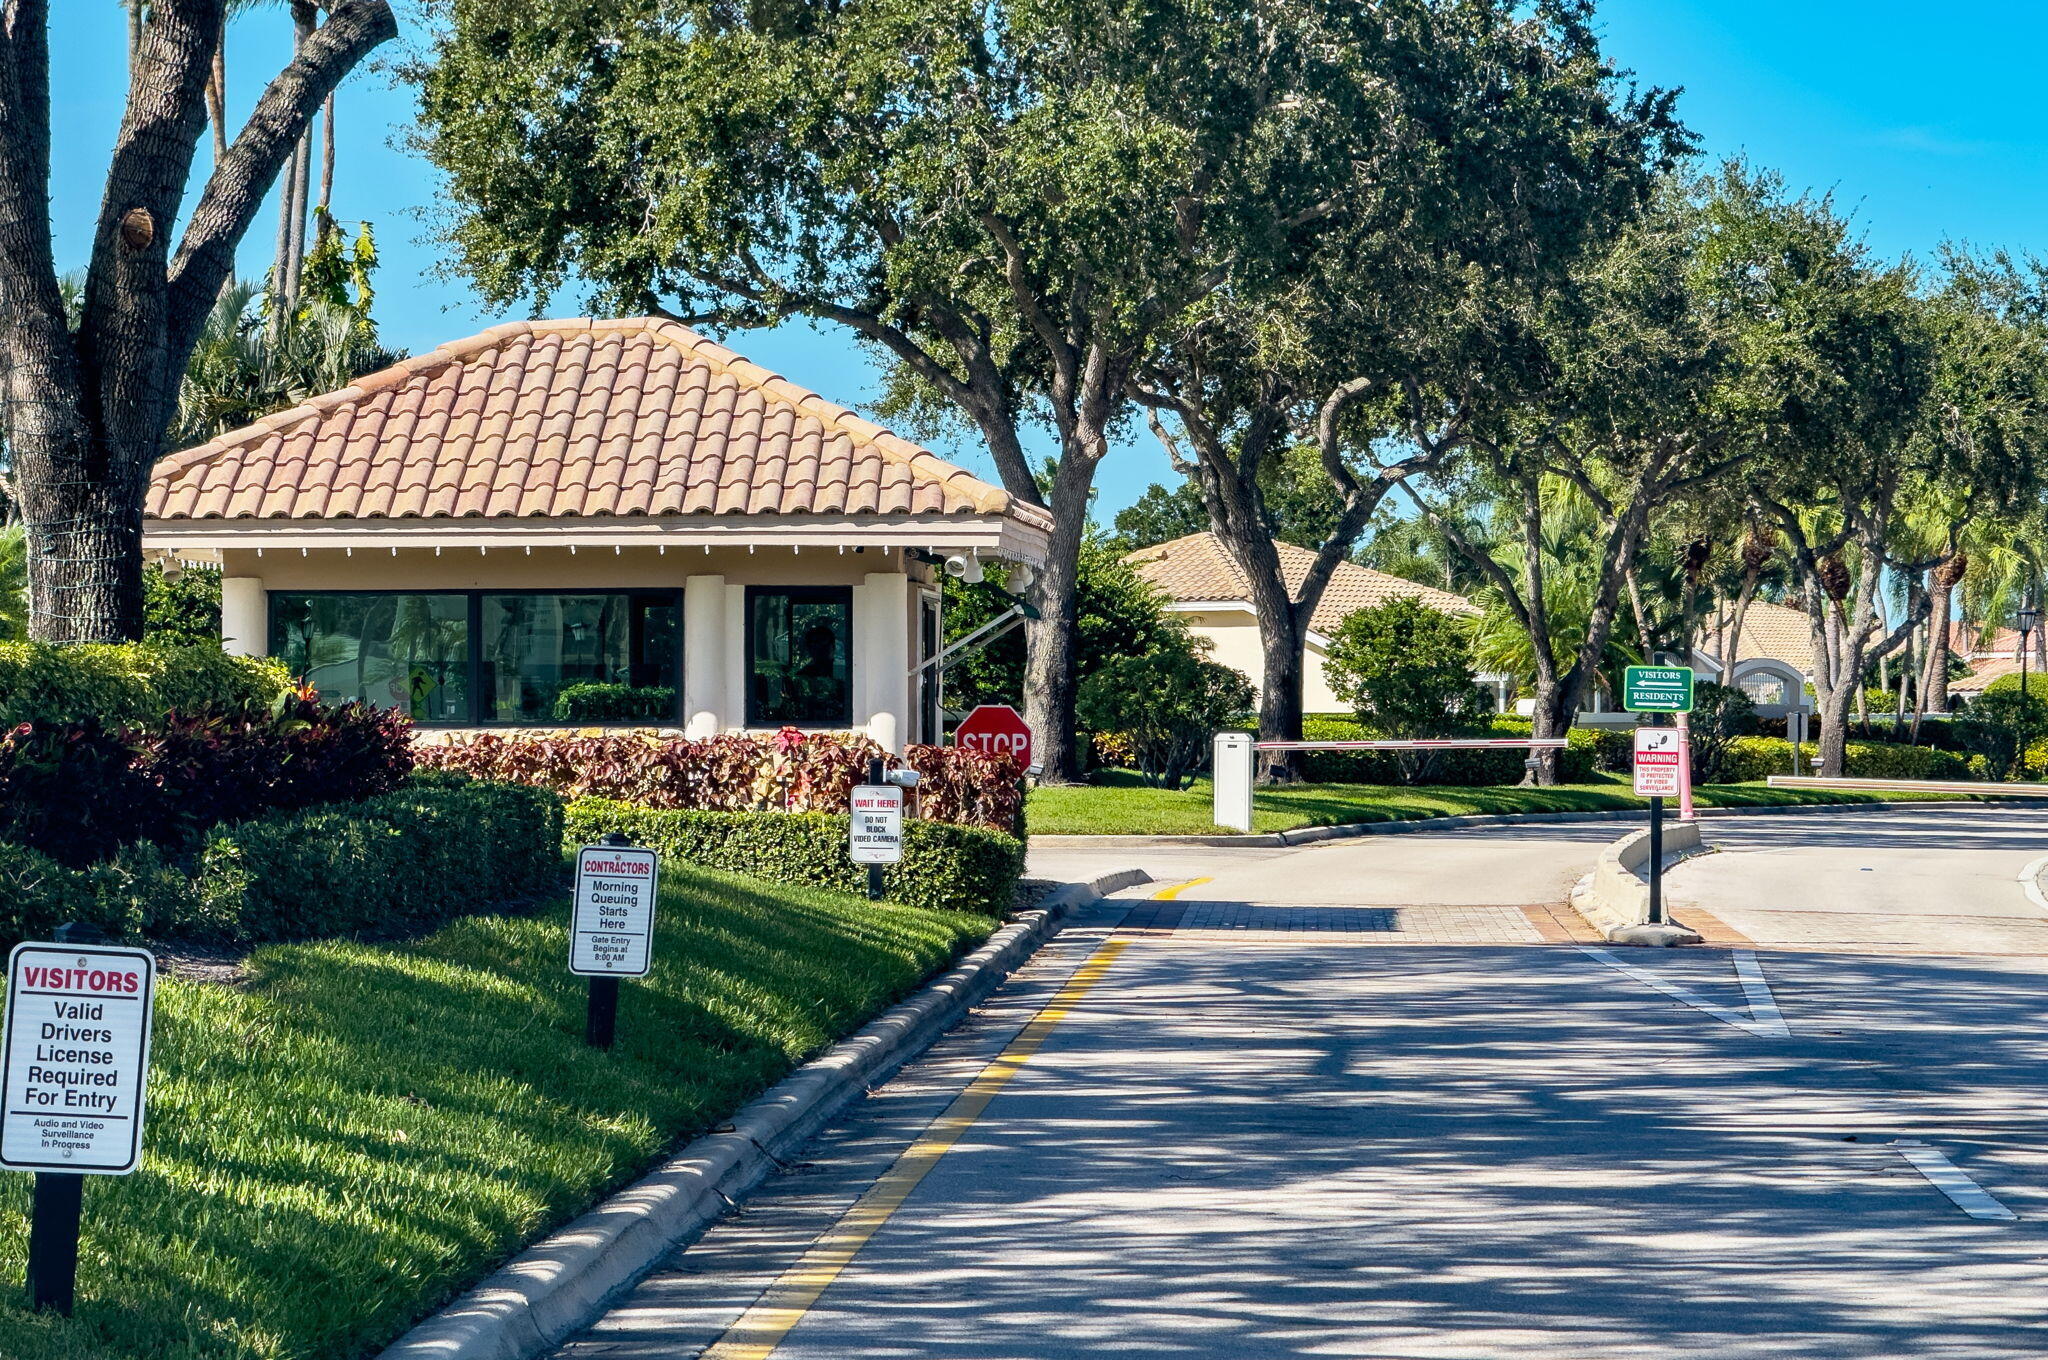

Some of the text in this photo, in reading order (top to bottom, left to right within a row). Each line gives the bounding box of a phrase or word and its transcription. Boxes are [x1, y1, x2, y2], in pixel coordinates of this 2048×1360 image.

[1638, 671, 1681, 680] VISITORS
[1633, 692, 1684, 701] RESIDENTS
[963, 732, 1028, 756] STOP
[1637, 753, 1678, 763] WARNING
[855, 799, 899, 808] WAIT HERE!
[864, 816, 888, 824] DO NOT
[853, 835, 899, 843] VIDEO CAMERA
[584, 860, 650, 875] CONTRACTORS
[592, 880, 639, 894] Morning
[591, 893, 638, 907] Queuing
[599, 906, 628, 917] Starts
[599, 918, 626, 929] Here
[591, 936, 631, 946] Gate Entry
[593, 945, 619, 953] Begins
[594, 953, 625, 962] 8:00 AM
[24, 966, 139, 993] VISITORS
[54, 1001, 103, 1021] Valid
[41, 1022, 112, 1043] Drivers
[36, 1044, 113, 1065] License
[28, 1066, 118, 1088] Required
[25, 1087, 118, 1112] For Entry
[33, 1118, 104, 1130] Audio and Video
[41, 1128, 94, 1139] Surveillance
[41, 1139, 91, 1150] In Progress
